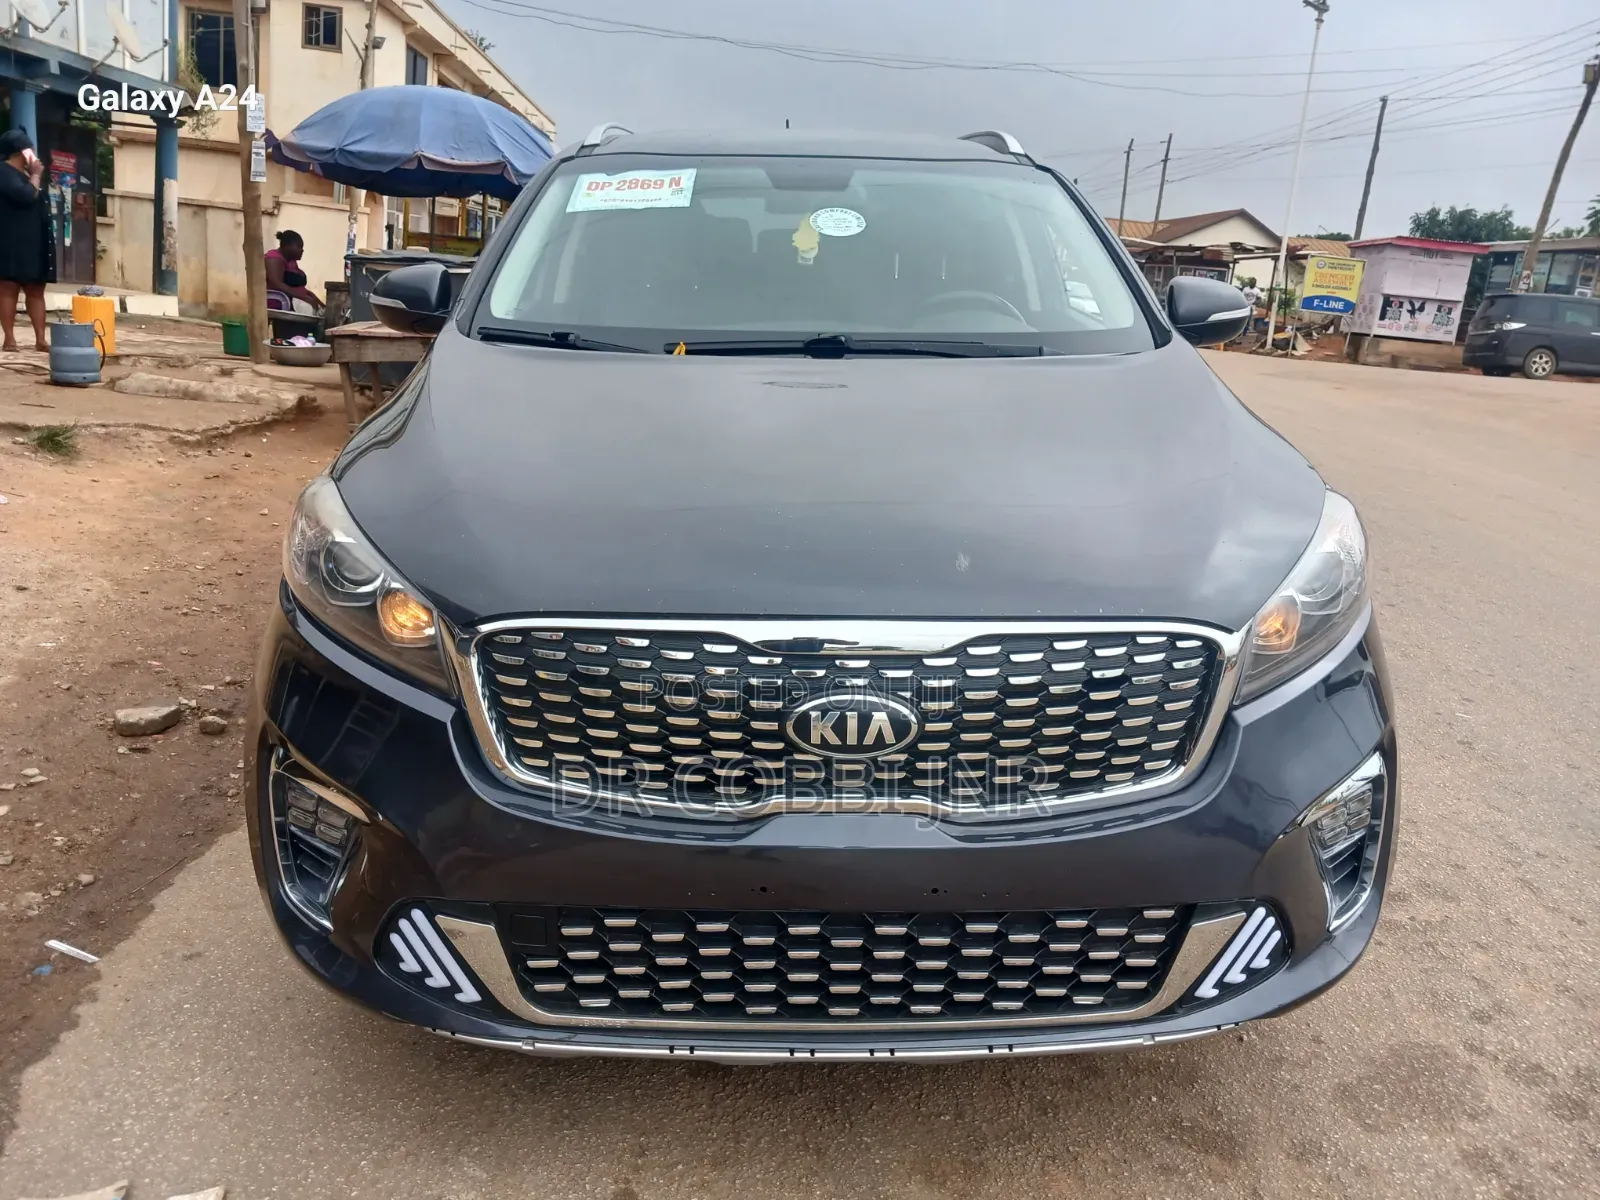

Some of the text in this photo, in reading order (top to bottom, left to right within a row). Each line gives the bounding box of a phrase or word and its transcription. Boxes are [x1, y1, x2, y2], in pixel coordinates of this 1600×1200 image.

[586, 176, 682, 192] DP 2869 N
[1313, 298, 1345, 310] F-LINE
[809, 711, 896, 745] KIA
